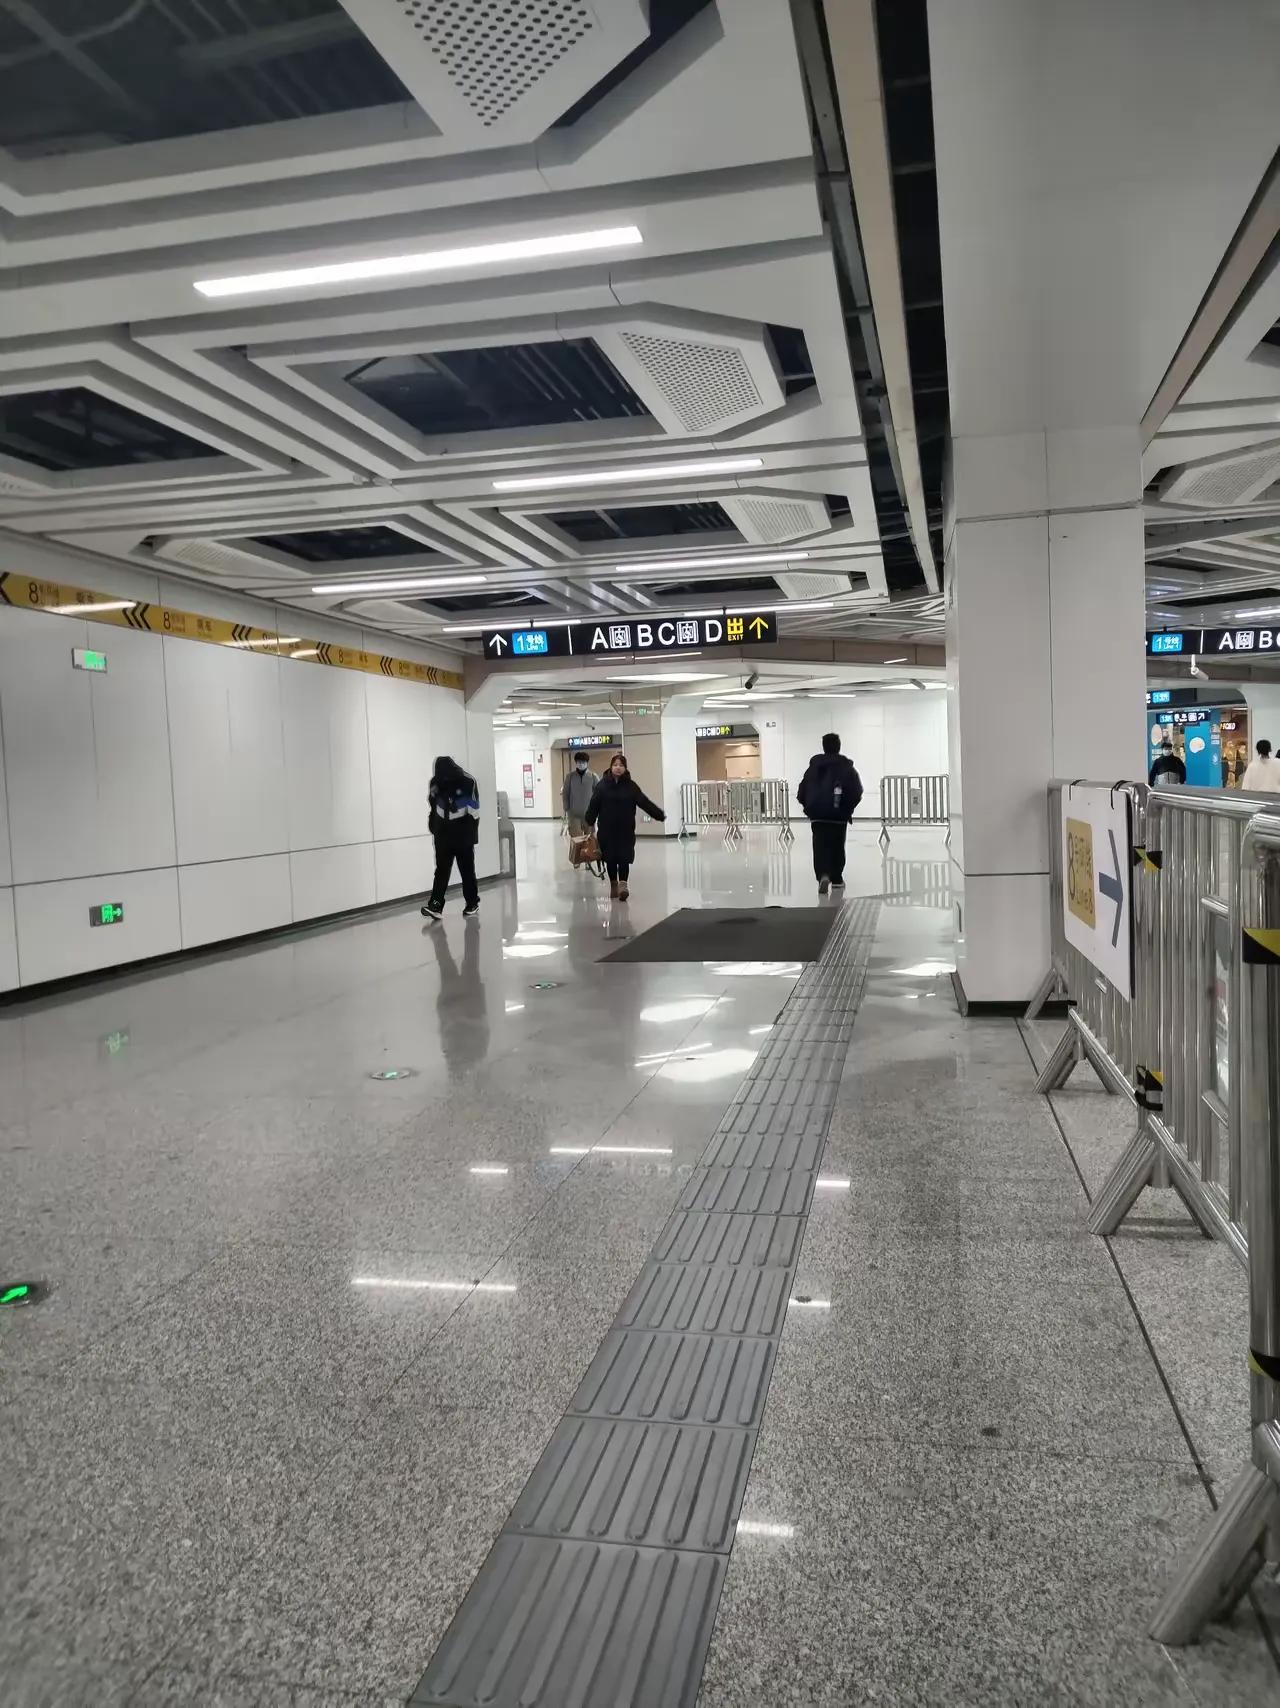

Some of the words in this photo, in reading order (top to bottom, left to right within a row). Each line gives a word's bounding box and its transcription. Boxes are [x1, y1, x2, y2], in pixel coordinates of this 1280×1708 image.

[591, 627, 608, 650] A
[637, 624, 654, 647] B
[658, 622, 676, 646] C
[706, 619, 723, 642] D
[1219, 632, 1234, 650] A
[1259, 631, 1272, 648] B
